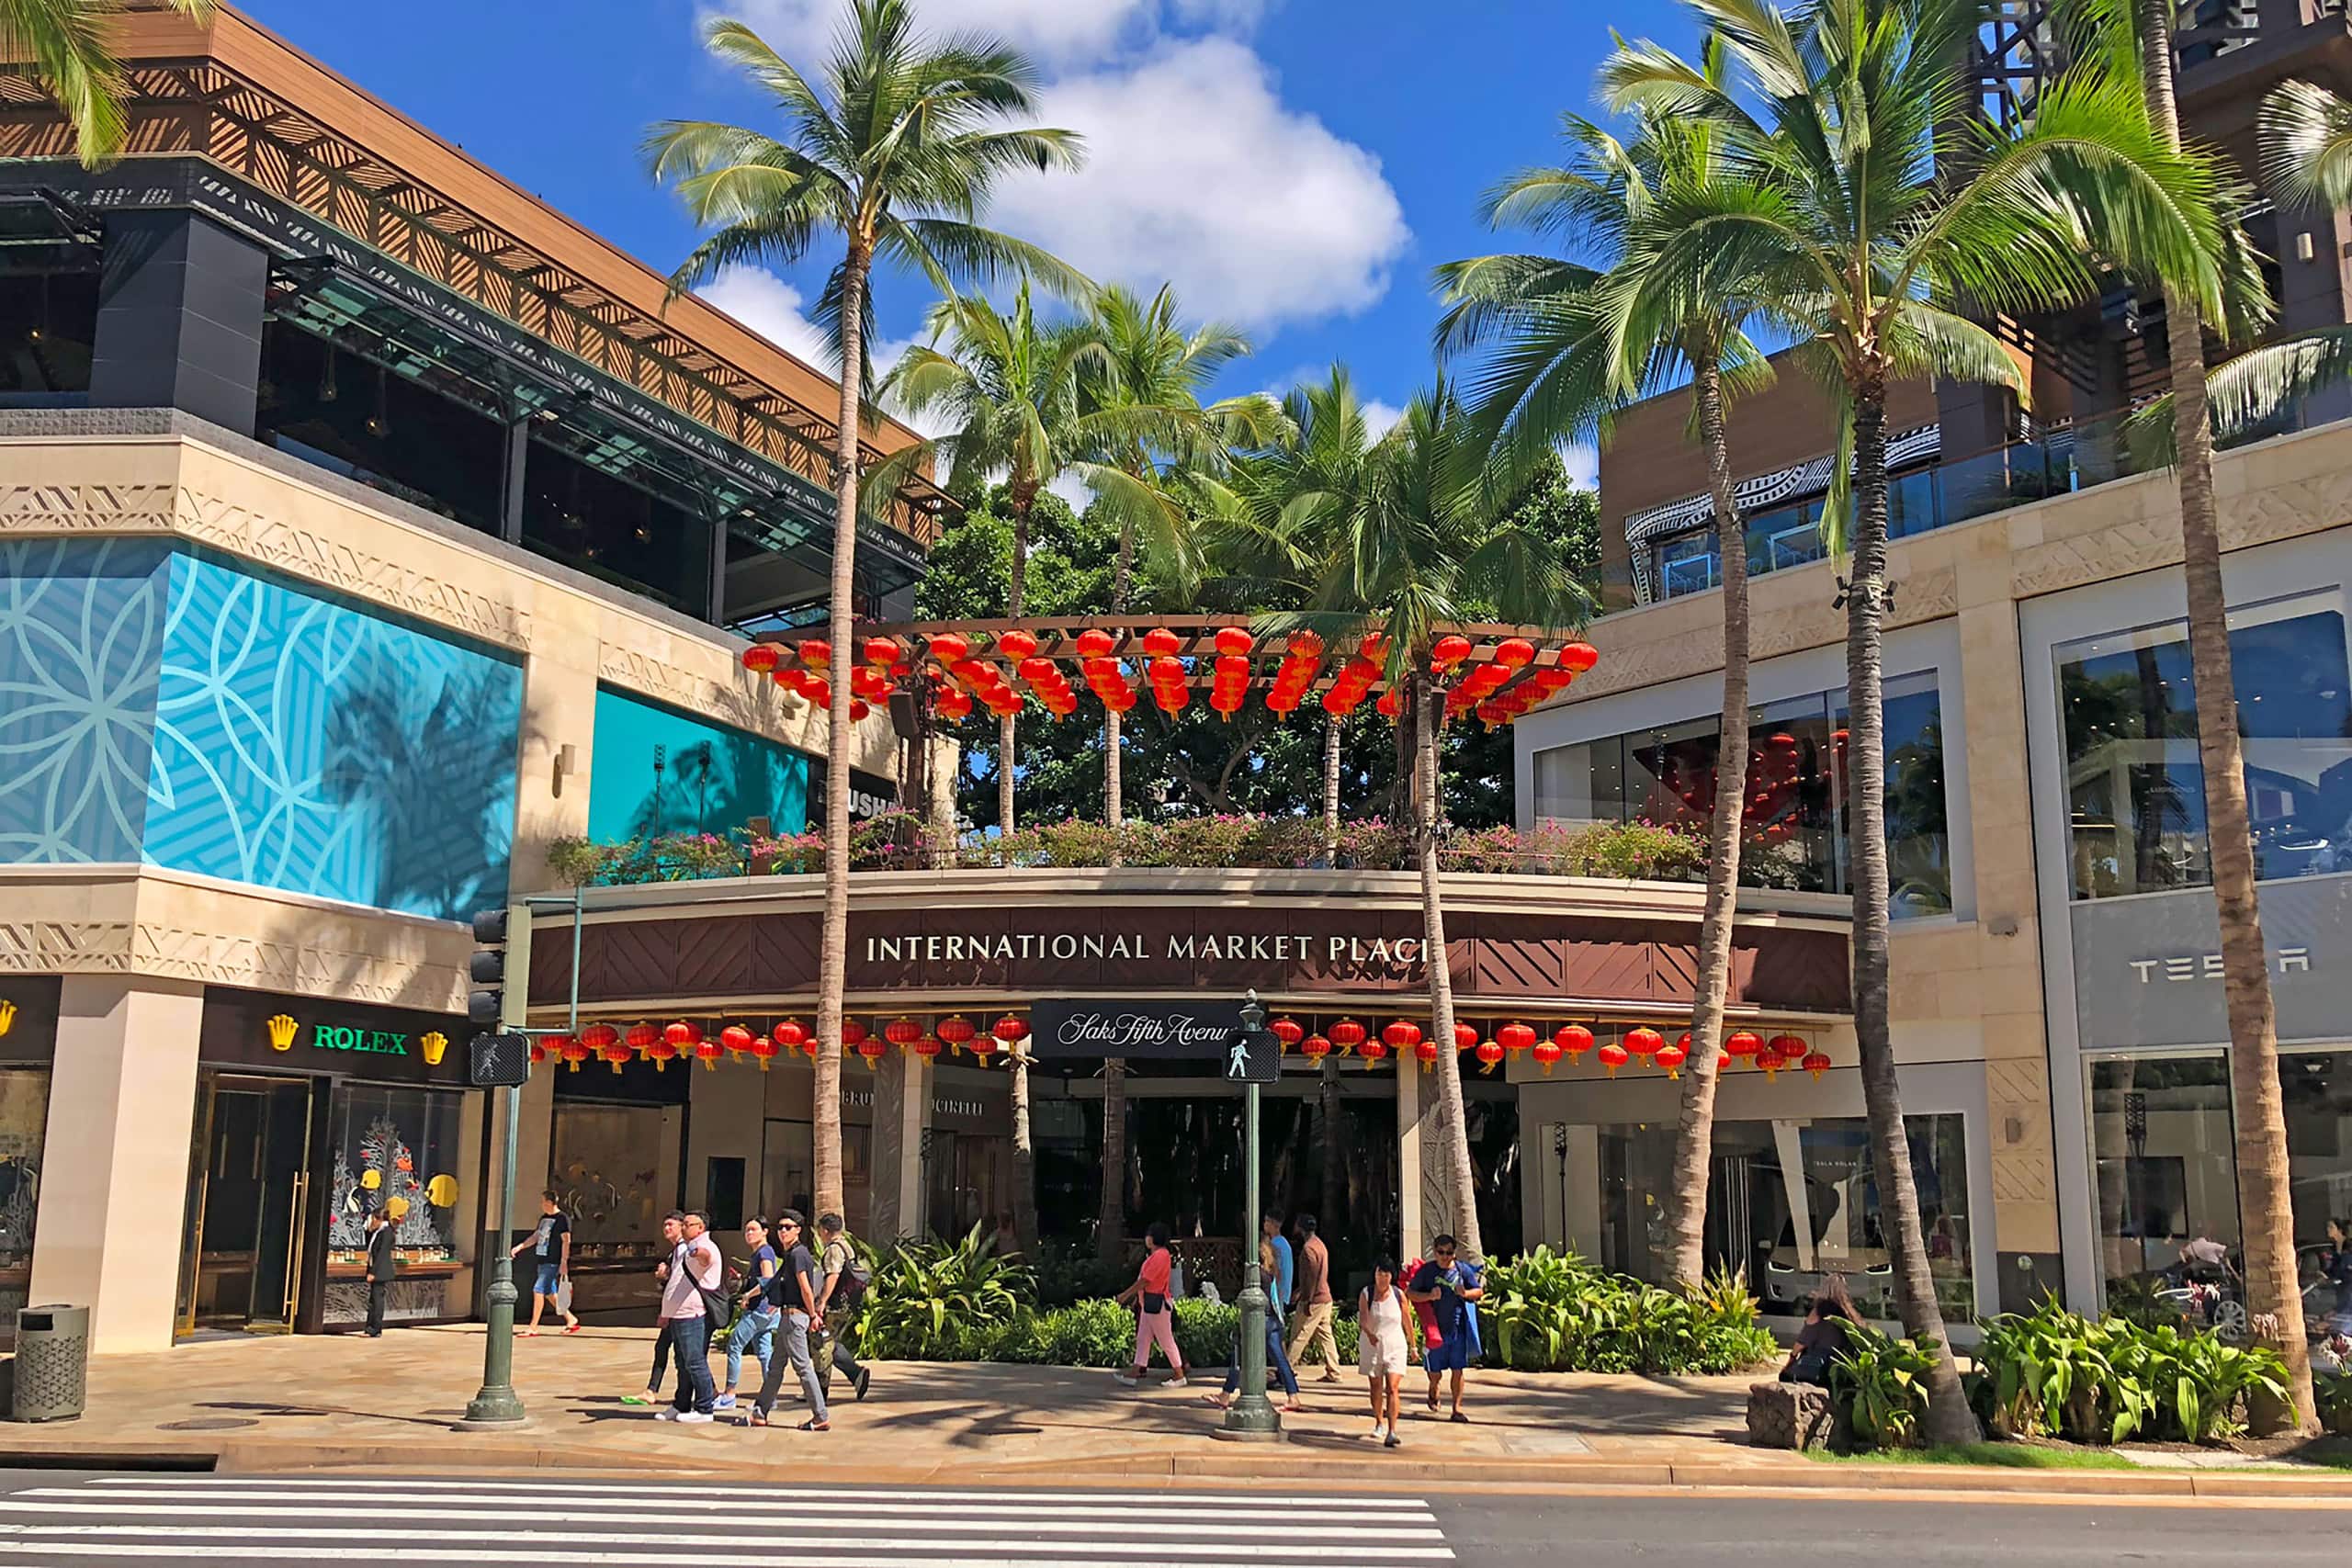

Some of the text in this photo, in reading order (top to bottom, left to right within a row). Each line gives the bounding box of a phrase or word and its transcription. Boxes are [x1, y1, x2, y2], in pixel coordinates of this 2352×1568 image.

[866, 934, 1149, 962] INTERNATIONAL
[1167, 934, 1313, 960] MARKET
[2129, 947, 2309, 983] TESA
[313, 1025, 408, 1055] ROLEX
[1057, 1013, 1231, 1045] Saks Fifth Avenu
